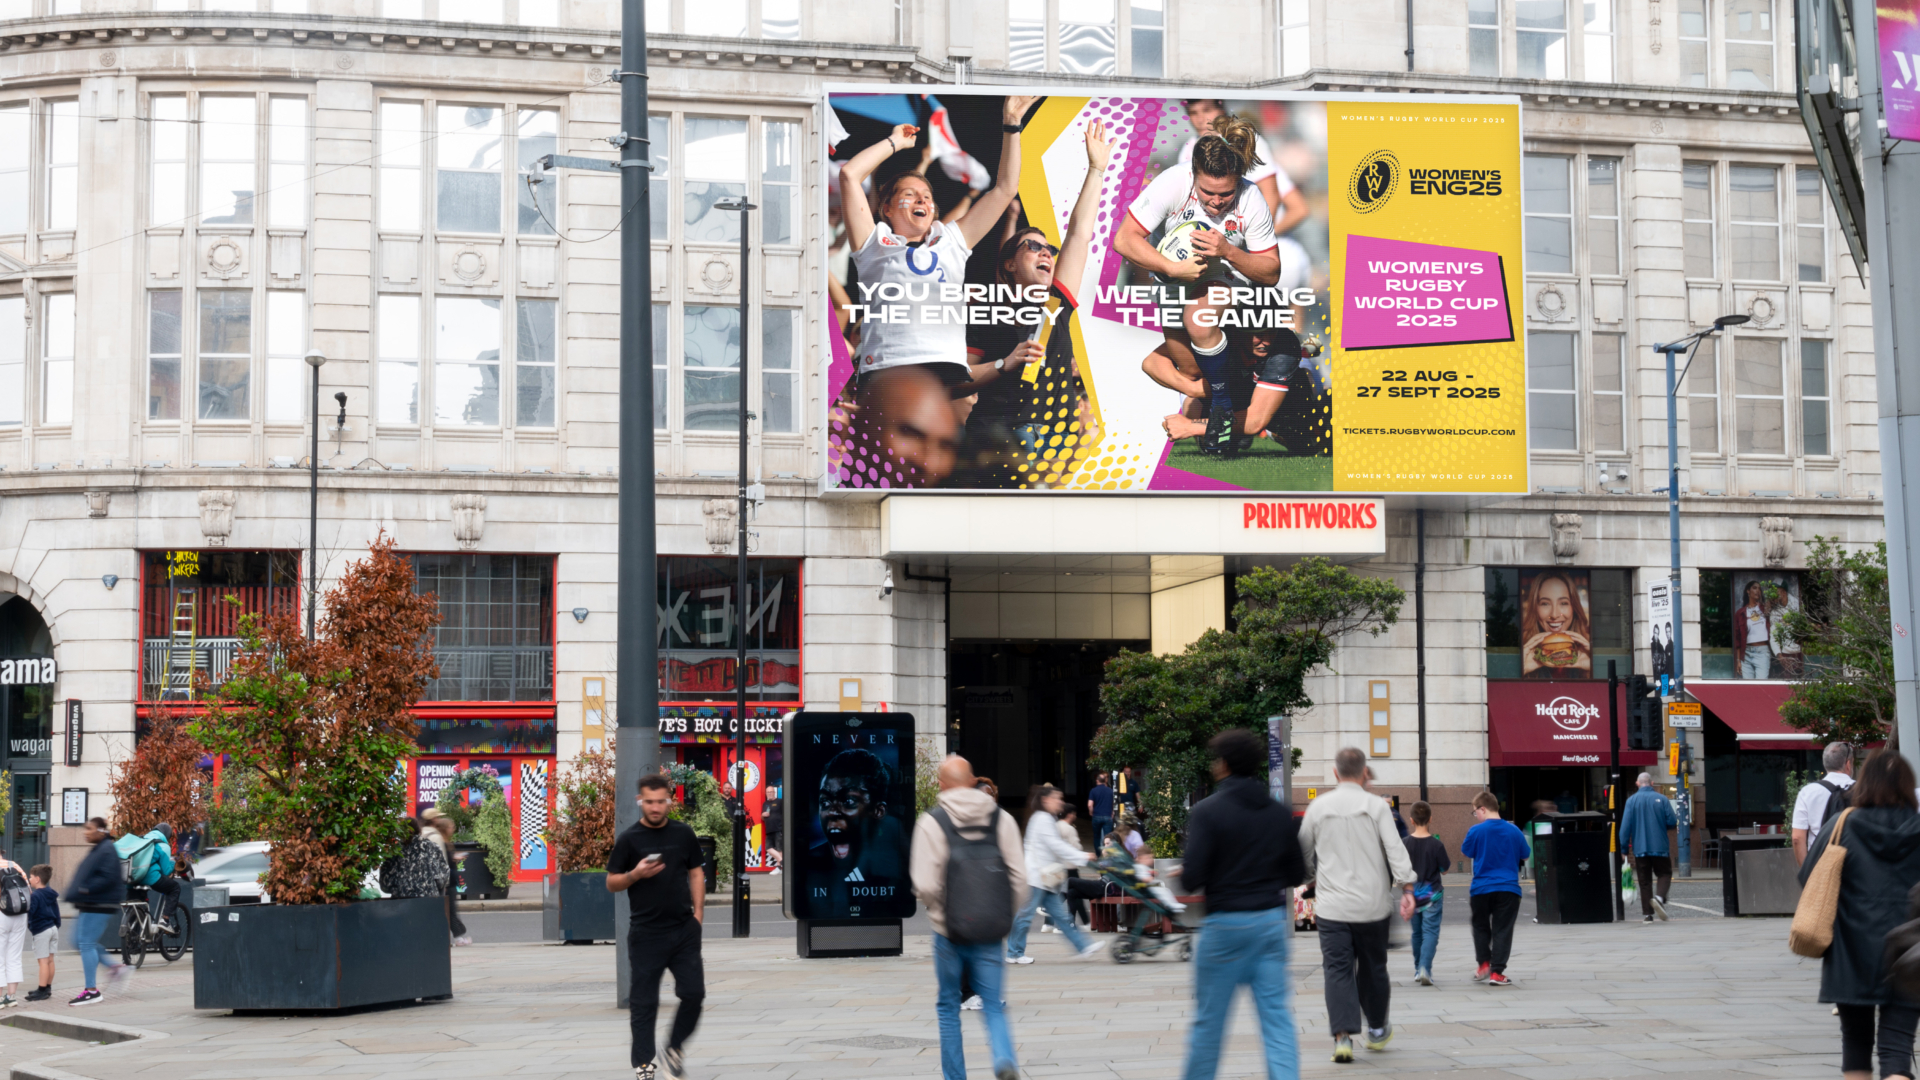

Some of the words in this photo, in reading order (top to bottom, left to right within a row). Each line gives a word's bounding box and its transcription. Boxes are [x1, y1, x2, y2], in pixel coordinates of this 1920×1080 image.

[1408, 169, 1502, 180] WOMEN'S
[1410, 180, 1502, 196] ENG25
[1368, 261, 1484, 274] WOMEN'S
[1385, 279, 1467, 292] RUGBY
[857, 282, 929, 301] YOU
[940, 283, 1049, 303] BRING
[1095, 284, 1198, 305] WE'LL
[1207, 286, 1316, 306] BRING
[1354, 296, 1443, 309] WORLD
[1450, 297, 1498, 310] CUP
[842, 304, 910, 324] THE
[920, 305, 1064, 325] ENERGY
[1116, 307, 1183, 326] THE
[1192, 308, 1295, 328] GAME
[1396, 314, 1457, 327] 2025
[1382, 370, 1407, 381] 22
[1414, 370, 1458, 382] AUG
[1357, 386, 1381, 398] 27
[1388, 386, 1440, 398] SEPT
[1446, 387, 1501, 398] 2025
[1342, 428, 1516, 436] TICKETS.RUGBYWORLDCUP.COM
[1243, 503, 1377, 529] PRINTWORKS
[1535, 703, 1567, 716] Hard
[1568, 703, 1600, 718] Rock
[694, 718, 723, 733] HOT
[71, 704, 79, 761] wagamama
[813, 734, 895, 744] NEVER
[419, 777, 452, 790] AUGUST
[419, 790, 440, 803] 2025
[814, 887, 827, 897] IN
[852, 886, 895, 897] DOUBT
